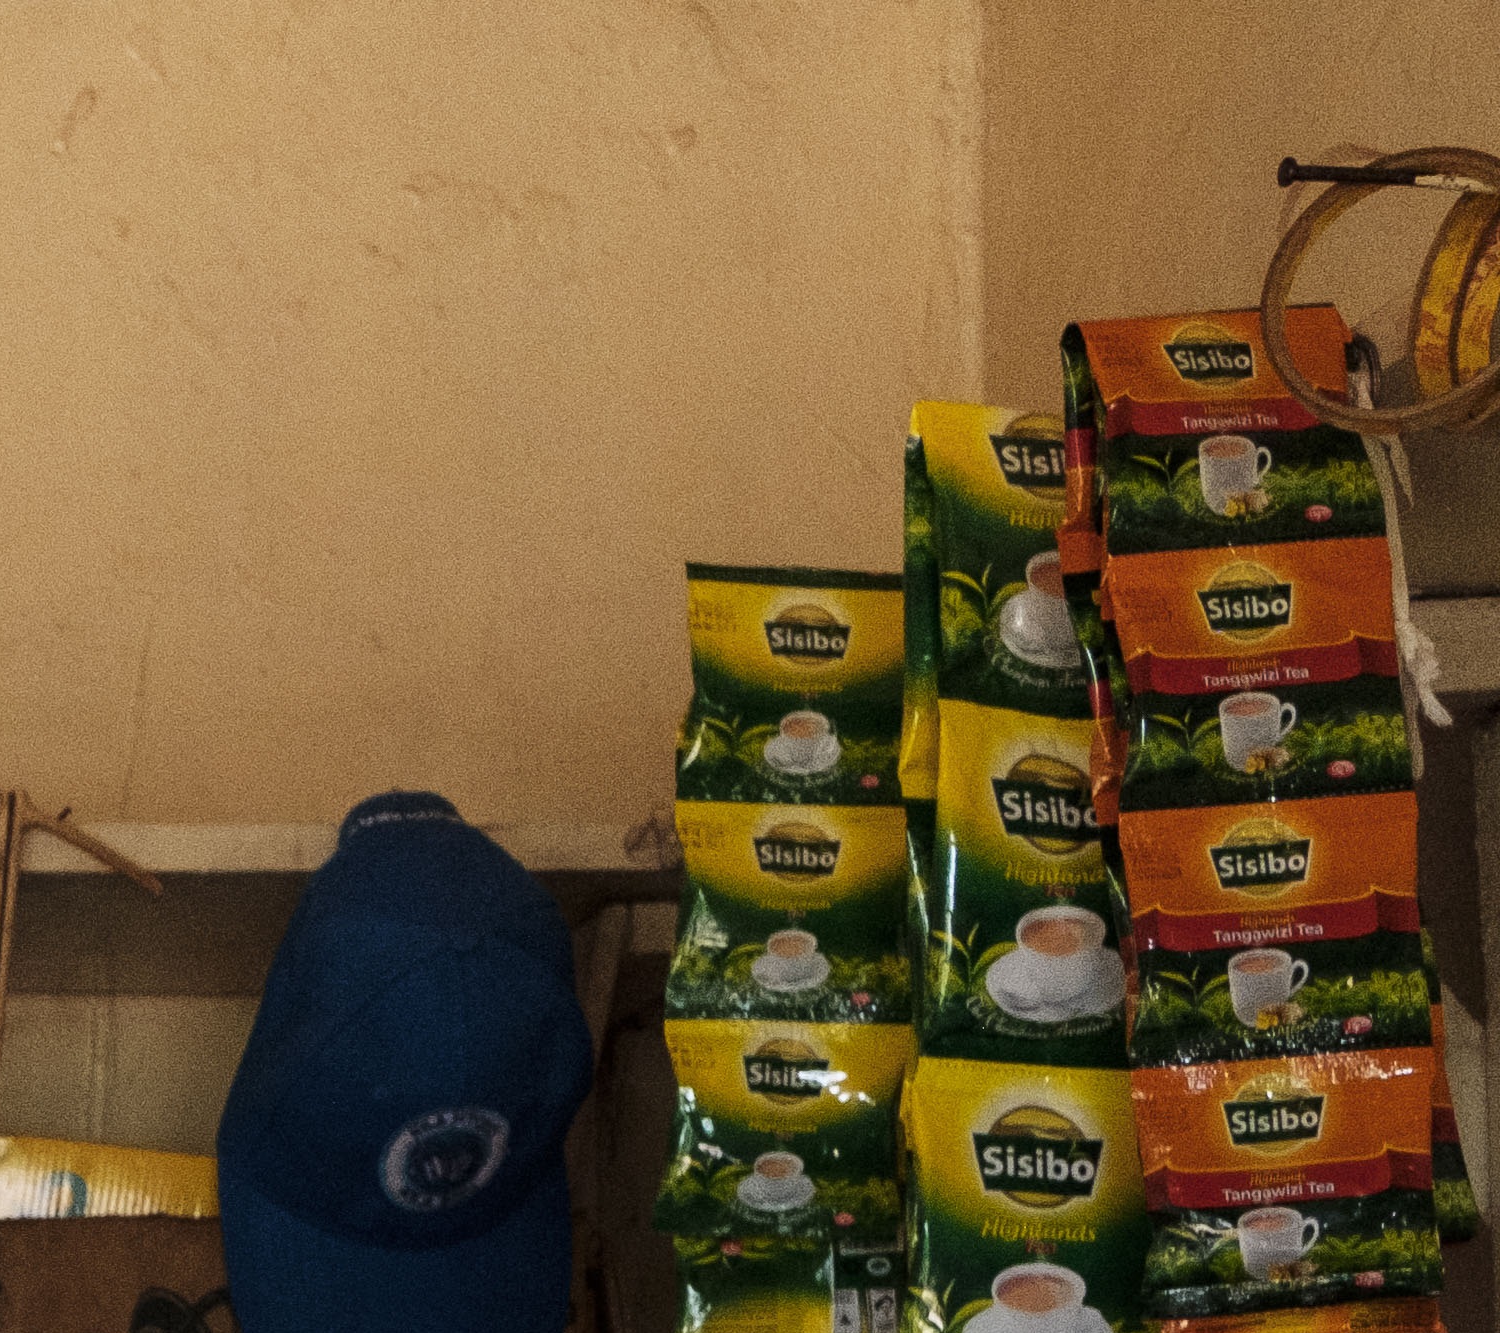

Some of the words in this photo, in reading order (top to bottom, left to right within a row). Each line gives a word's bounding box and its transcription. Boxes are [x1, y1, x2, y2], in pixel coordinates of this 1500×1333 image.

[1174, 348, 1250, 372] Sisibo
[1181, 414, 1252, 432] Tangawizi
[1256, 412, 1279, 427] Tea
[1206, 595, 1288, 620] Sisibo
[771, 627, 846, 652] Sisibo
[1203, 666, 1280, 690] Tangawizi
[1282, 664, 1310, 681] Tea
[1002, 790, 1098, 828] Sisibo
[759, 845, 836, 869] Sisibo
[1218, 850, 1306, 879] Sisibo
[1213, 924, 1293, 948] Tangawizi
[1296, 922, 1325, 938] Tea
[1231, 1110, 1320, 1136] Sisibo
[983, 1146, 1096, 1183] Sisibo
[1222, 1183, 1304, 1205] Tangawizi
[1307, 1181, 1336, 1196] Tea
